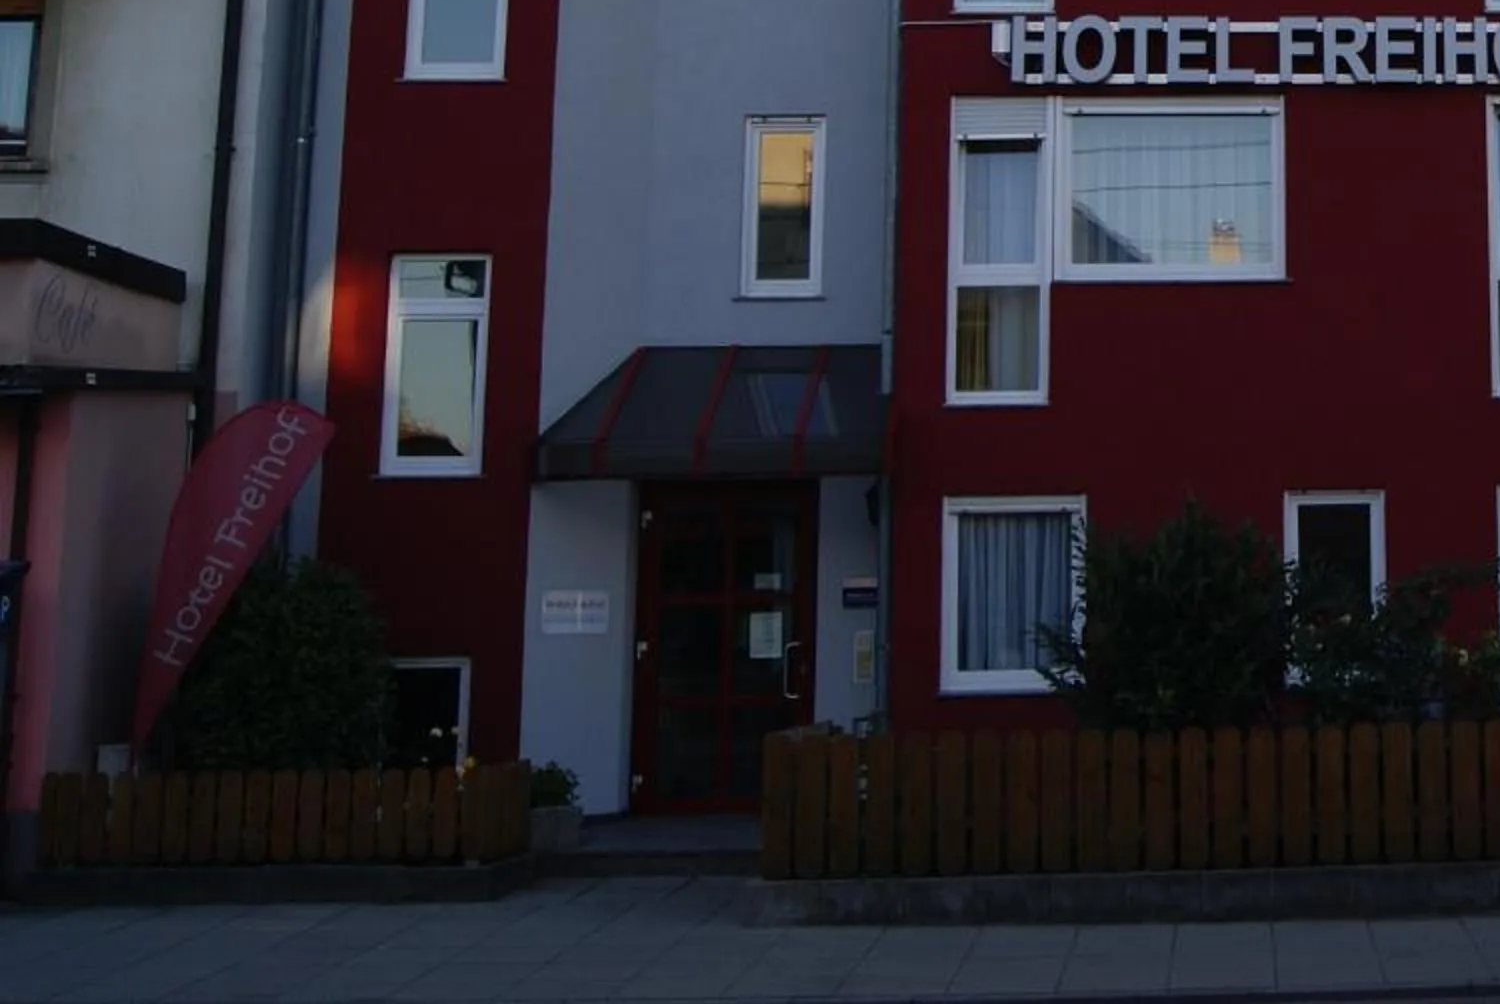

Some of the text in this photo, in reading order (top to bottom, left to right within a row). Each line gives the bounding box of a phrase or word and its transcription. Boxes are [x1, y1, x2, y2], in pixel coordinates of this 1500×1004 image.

[1010, 14, 1254, 84] HOTEL
[153, 405, 308, 667] Hotel Freihof
